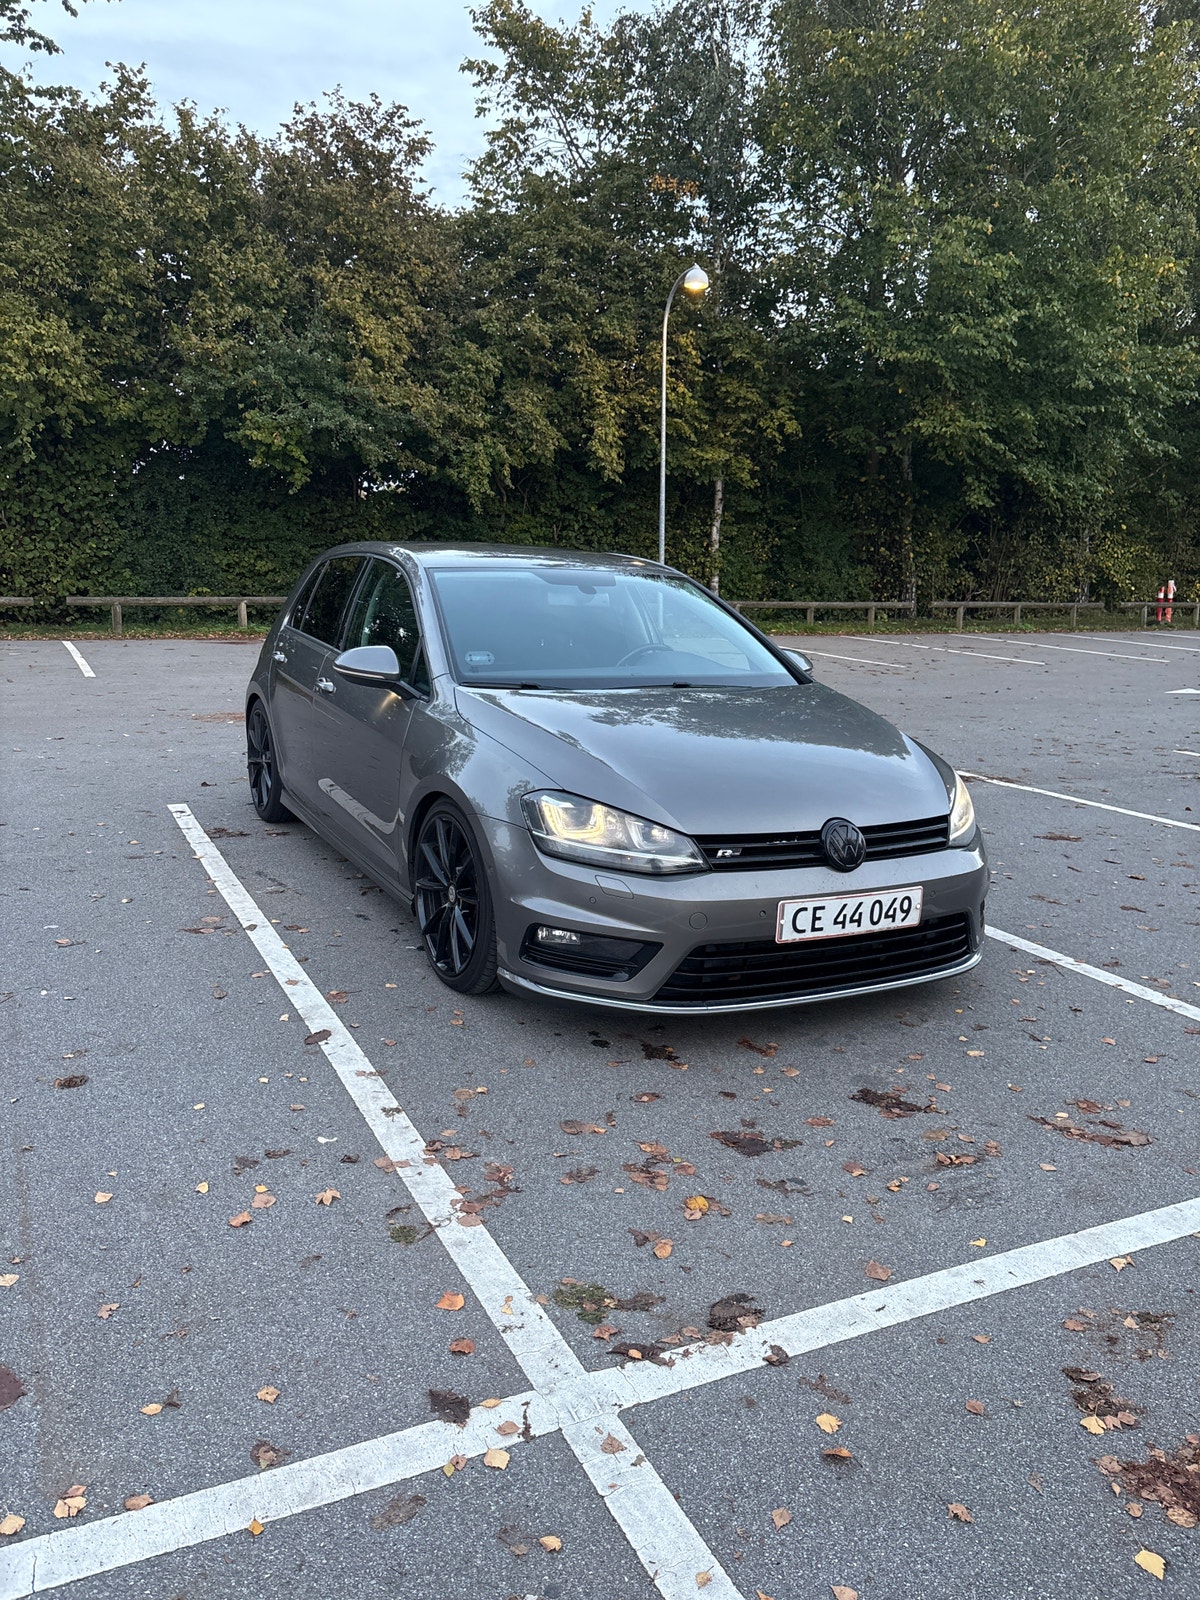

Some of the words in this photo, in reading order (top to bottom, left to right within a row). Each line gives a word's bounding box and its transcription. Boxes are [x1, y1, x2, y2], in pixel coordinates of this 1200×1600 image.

[827, 822, 865, 868] VW
[791, 905, 826, 934] CE
[833, 902, 863, 929] 44
[869, 895, 912, 926] 049
